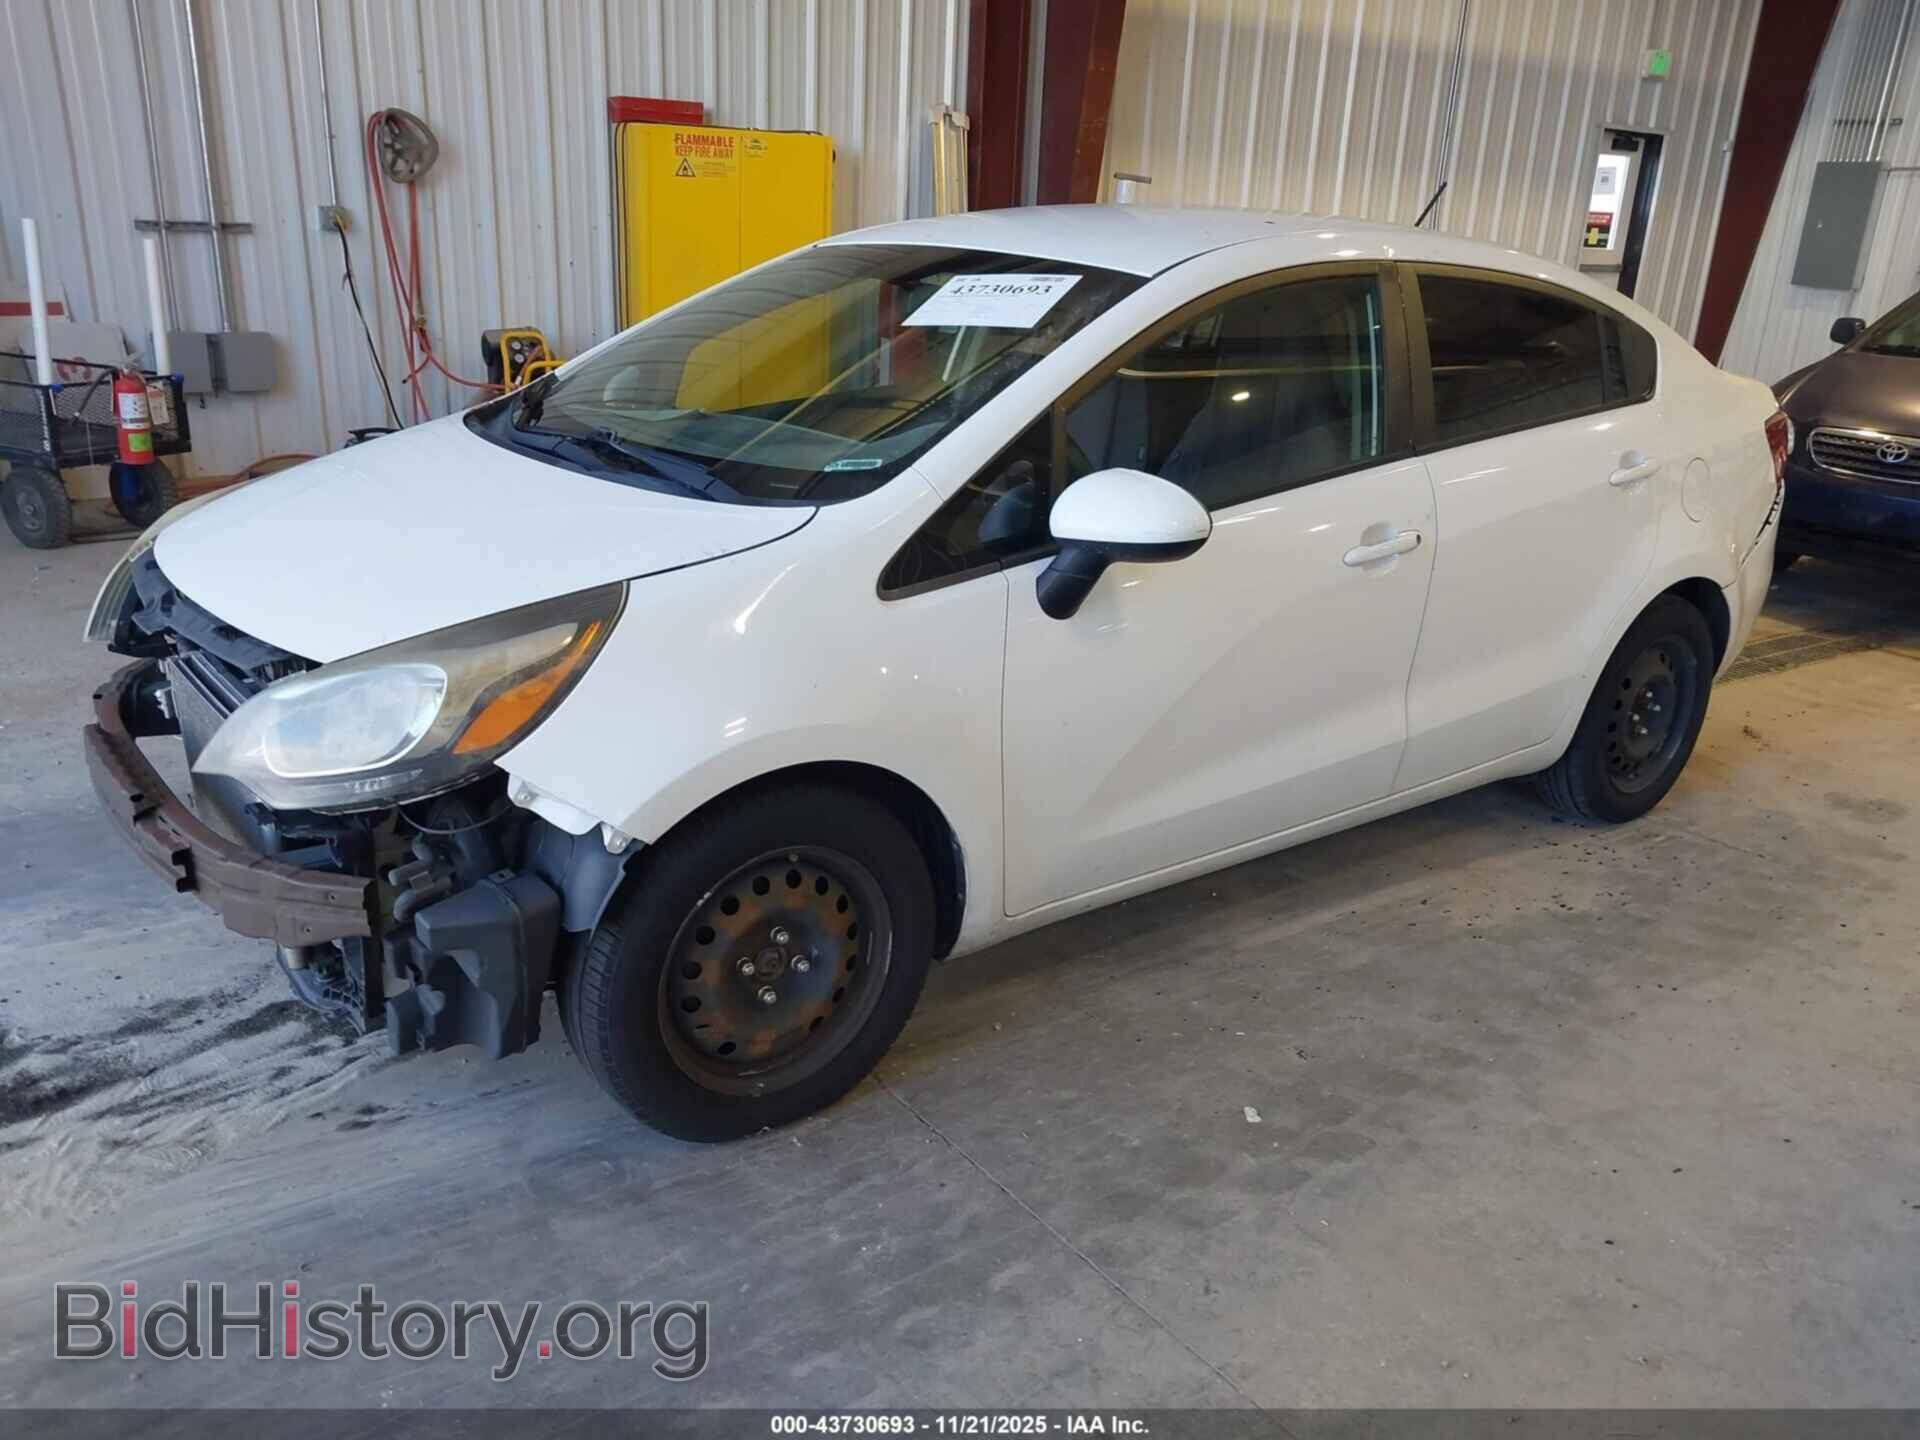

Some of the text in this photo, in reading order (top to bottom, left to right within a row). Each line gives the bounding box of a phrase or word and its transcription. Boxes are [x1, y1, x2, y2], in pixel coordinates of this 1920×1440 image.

[674, 133, 736, 148] FLAMMABLE
[675, 145, 694, 157] KEEP
[695, 146, 712, 158] FIRE
[713, 147, 735, 160] AWAY
[949, 283, 1053, 296] 43730693
